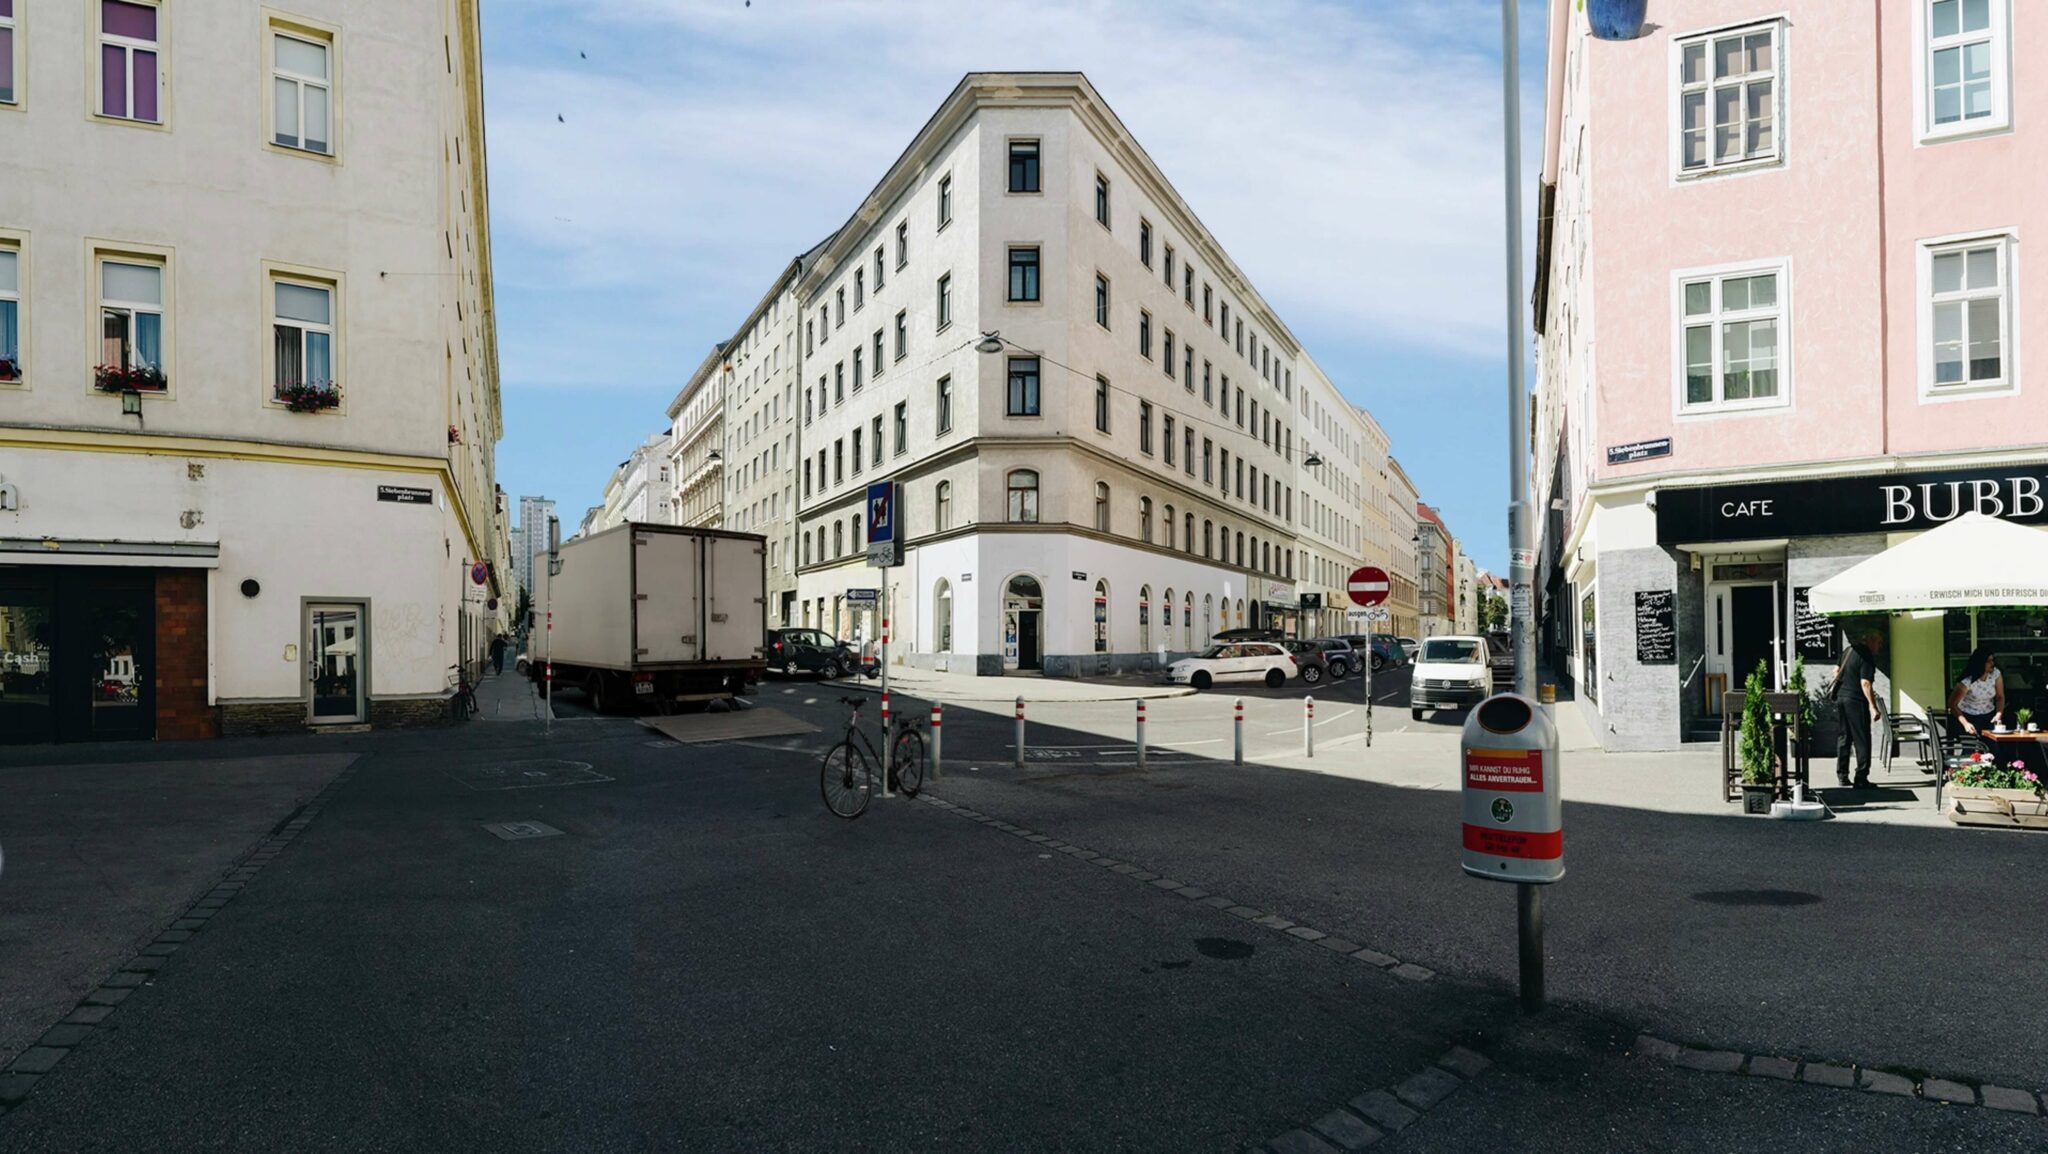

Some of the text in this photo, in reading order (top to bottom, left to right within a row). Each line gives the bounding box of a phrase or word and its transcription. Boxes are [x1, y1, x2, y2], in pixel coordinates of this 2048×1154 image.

[1879, 475, 2048, 524] BUBB
[1721, 499, 1774, 517] CAFE
[1930, 590, 1962, 599] ERWISCH
[1964, 589, 1983, 598] MICH
[1984, 588, 2000, 598] UND
[2001, 588, 2038, 598] ERFRISCH
[4, 651, 39, 665] Cash
[1480, 765, 1502, 773] KANNST
[1503, 766, 1512, 774] DU
[1512, 767, 1531, 775] RUHIG
[1470, 773, 1487, 781] ALLES
